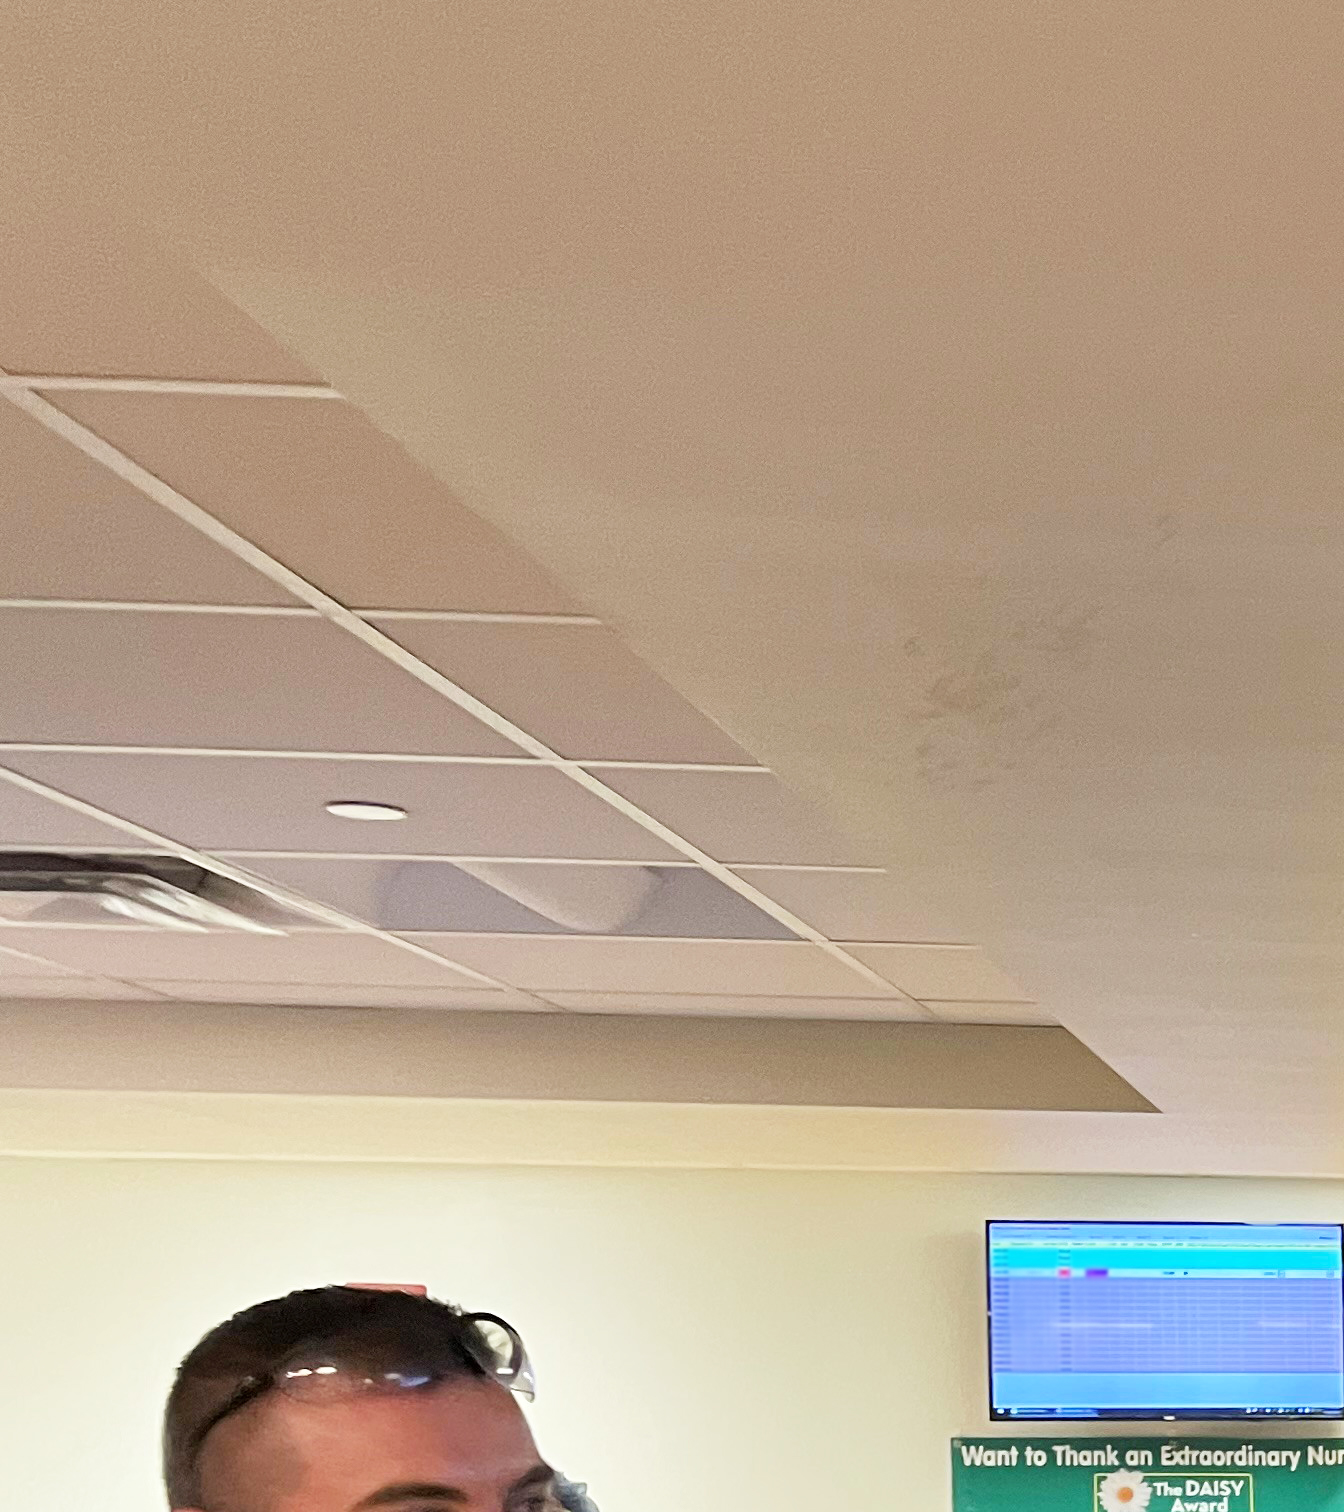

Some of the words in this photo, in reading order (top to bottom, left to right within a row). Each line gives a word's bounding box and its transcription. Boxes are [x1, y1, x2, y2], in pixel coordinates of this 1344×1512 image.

[961, 1445, 1019, 1467] Want
[1024, 1446, 1047, 1467] to
[1052, 1444, 1120, 1467] Thank
[1125, 1449, 1152, 1466] an
[1160, 1444, 1301, 1472] Extraordinary
[1152, 1482, 1183, 1497] The
[1185, 1480, 1244, 1497] DAISY
[1171, 1497, 1229, 1512] Award
